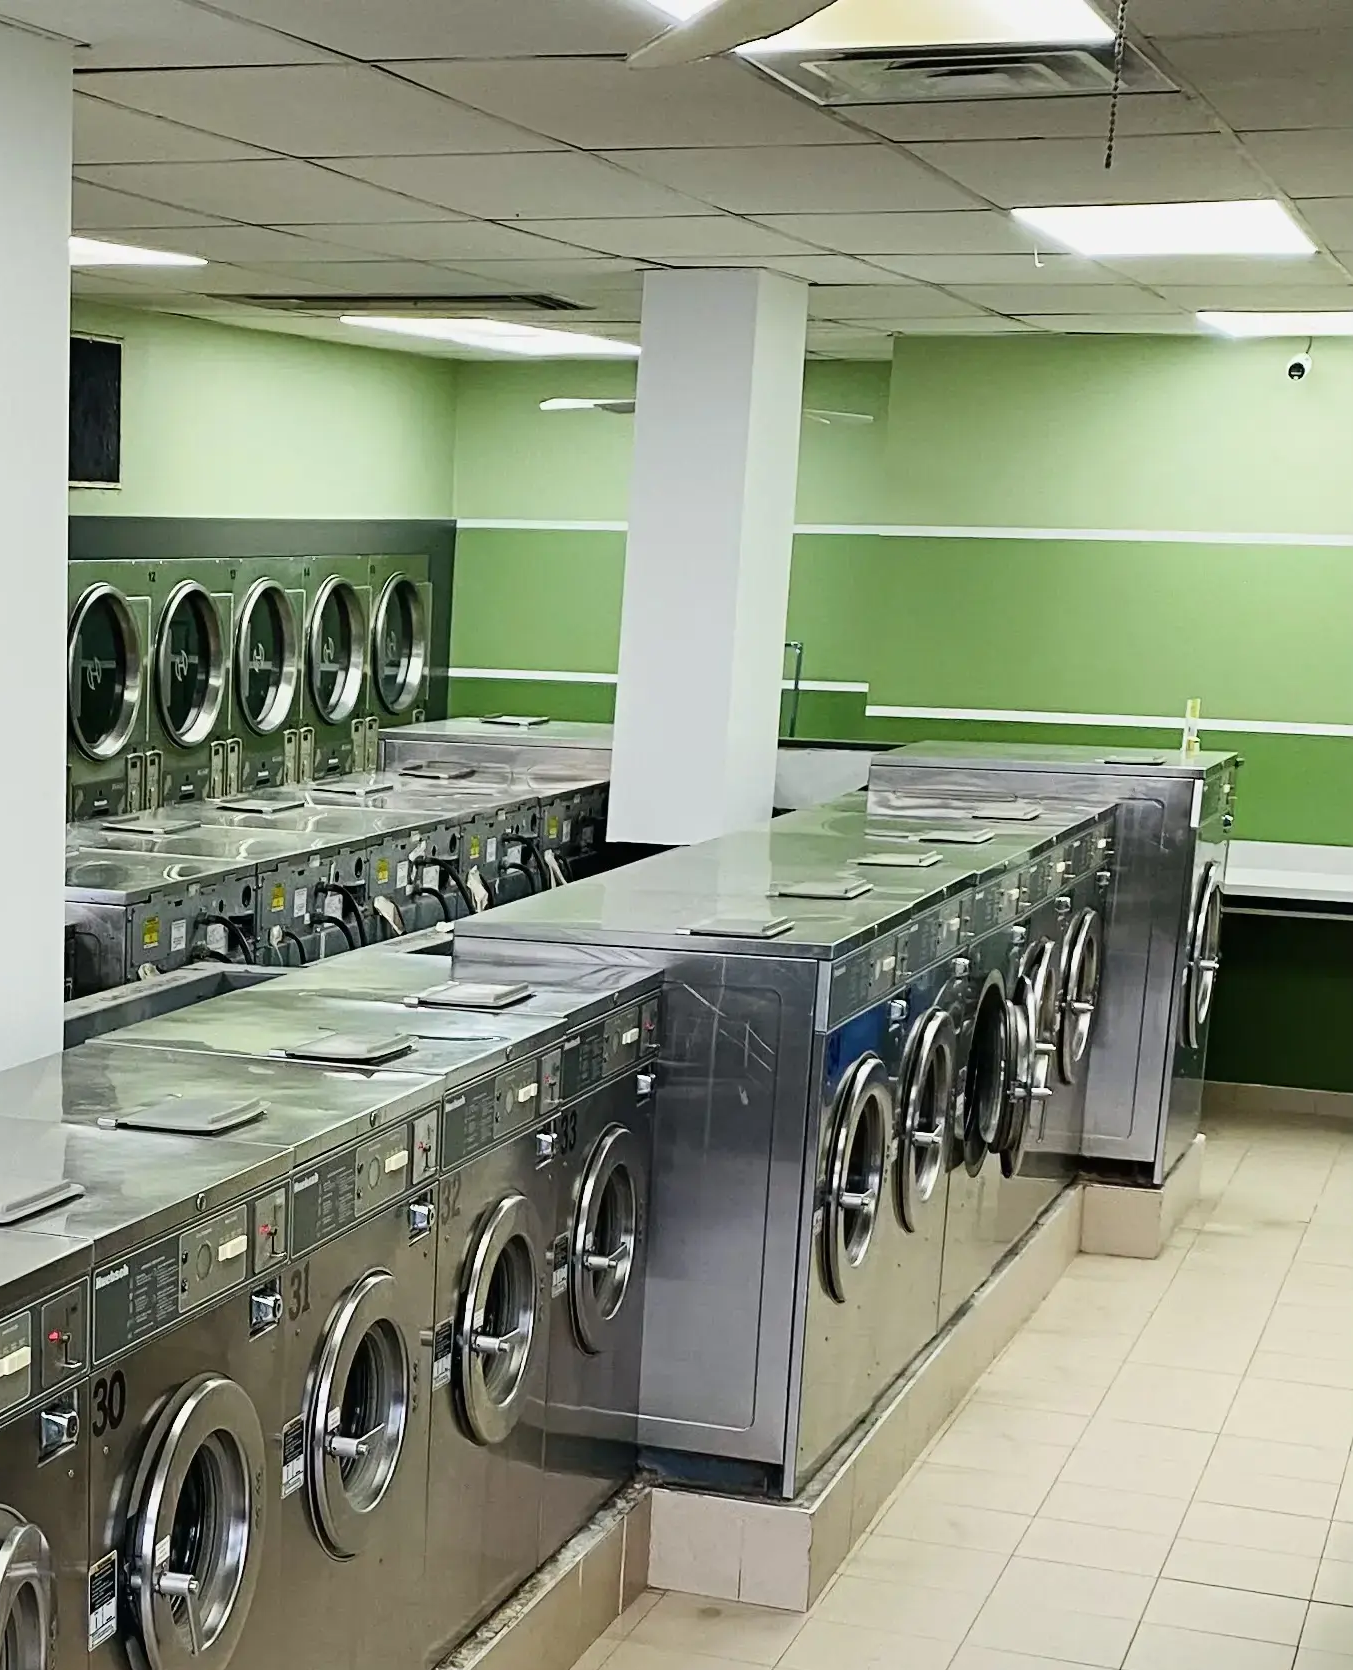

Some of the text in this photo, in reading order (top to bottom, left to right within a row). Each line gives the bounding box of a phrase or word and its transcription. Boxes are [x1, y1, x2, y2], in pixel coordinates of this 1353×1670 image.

[560, 1109, 577, 1156] 33
[289, 1260, 311, 1321] 31
[92, 1369, 126, 1438] 30
